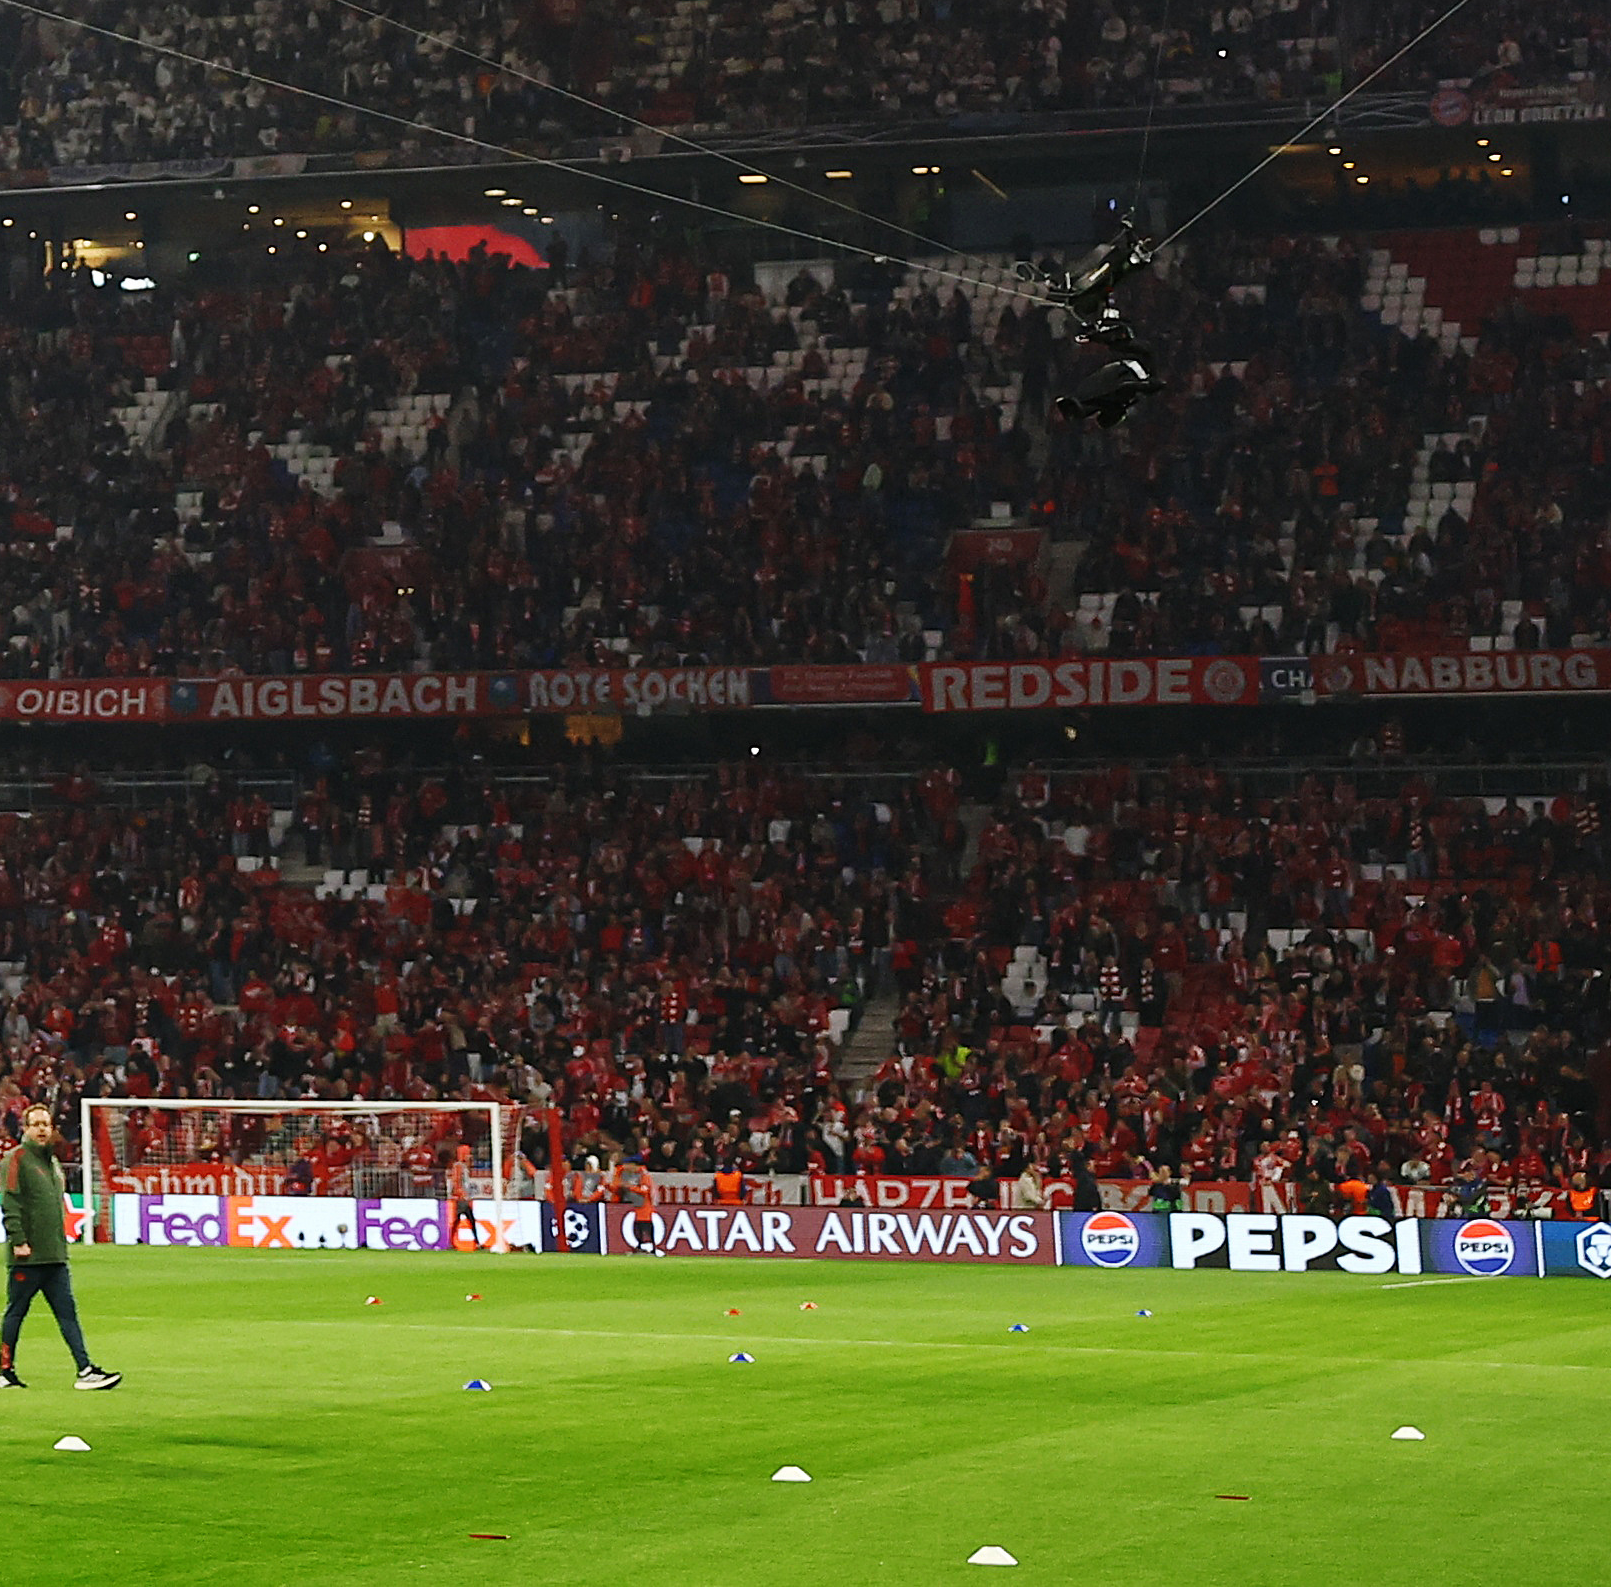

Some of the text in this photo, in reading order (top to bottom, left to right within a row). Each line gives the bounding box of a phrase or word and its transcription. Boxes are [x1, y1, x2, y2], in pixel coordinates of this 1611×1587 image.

[528, 671, 611, 707] ROTE
[623, 668, 750, 706] SOCKEN
[930, 659, 1193, 712] REDSIDE
[1363, 653, 1598, 691] NABBURG
[16, 687, 147, 717] OIBICH
[210, 676, 478, 717] AIGLSBACH
[140, 1195, 295, 1248] FedEx
[621, 1209, 1039, 1258] QATAR AIRWAYS
[1086, 1233, 1135, 1245] PEPSI
[1169, 1212, 1423, 1275] PEPSI
[1459, 1241, 1510, 1254] PEPSI
